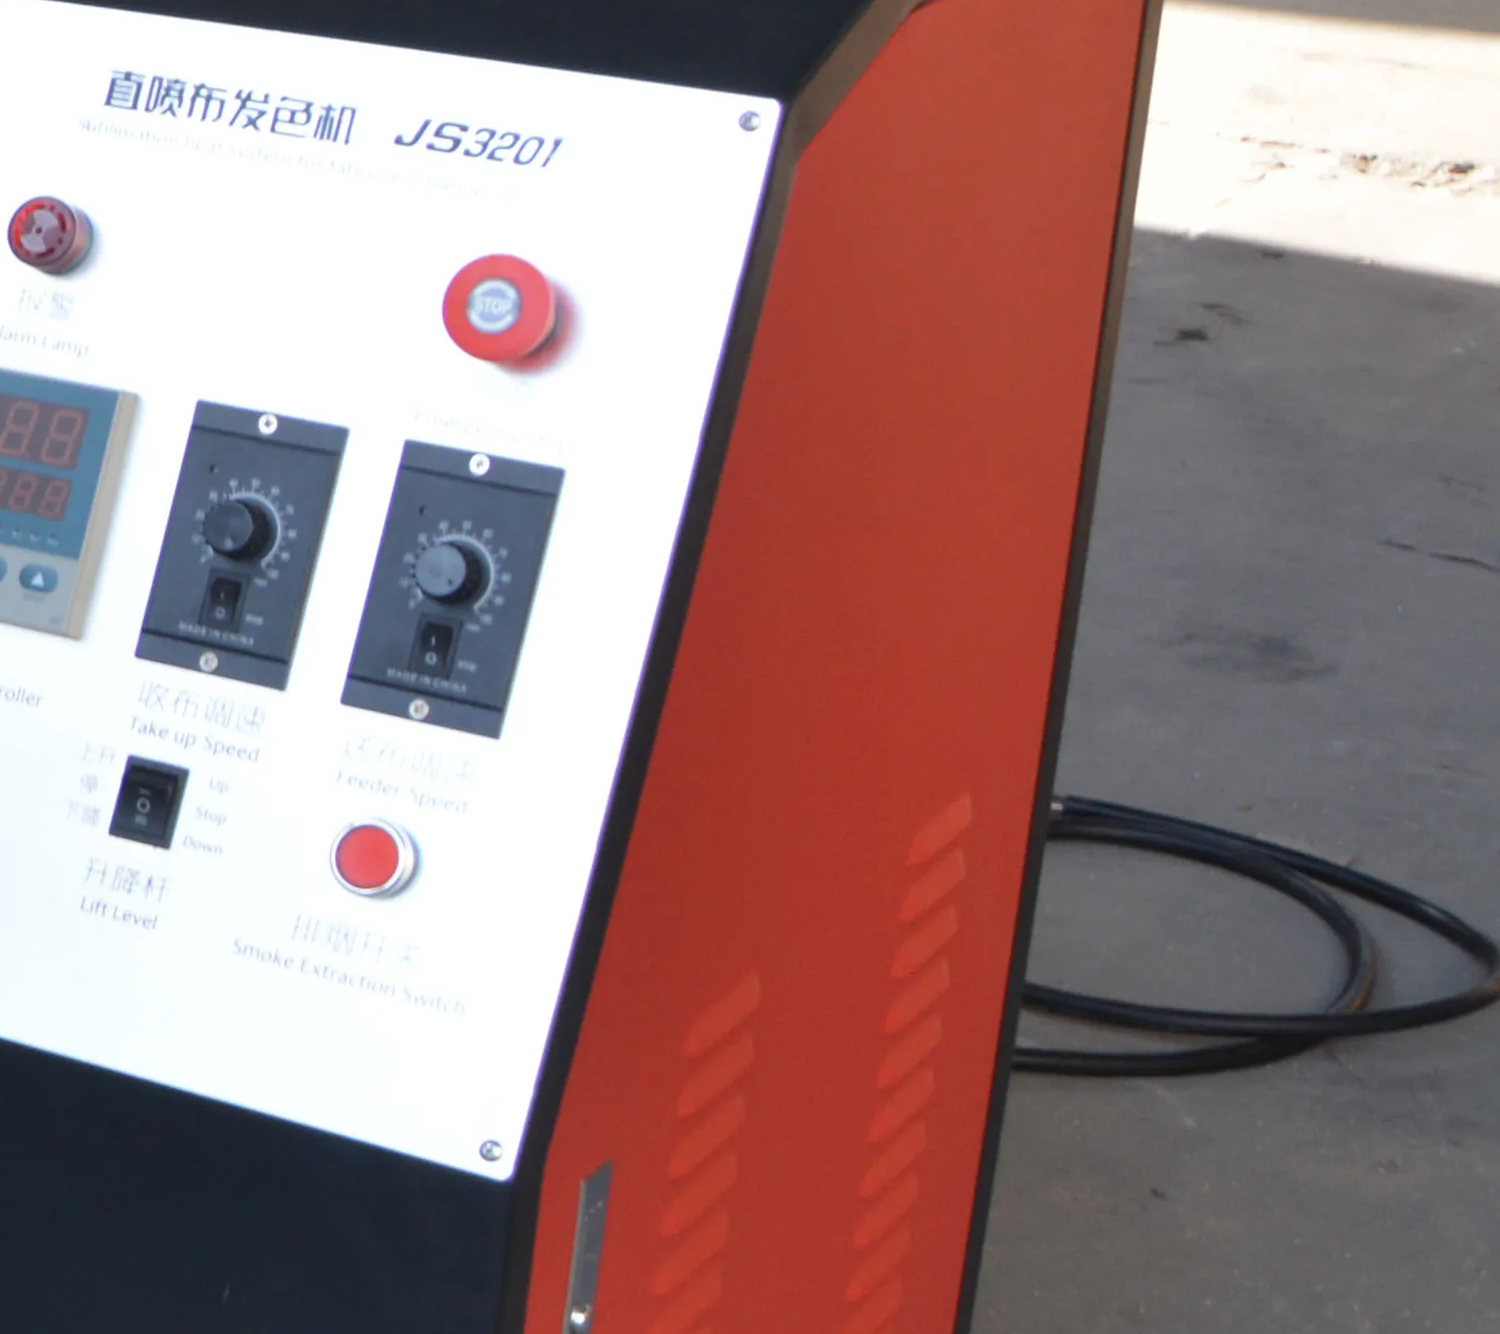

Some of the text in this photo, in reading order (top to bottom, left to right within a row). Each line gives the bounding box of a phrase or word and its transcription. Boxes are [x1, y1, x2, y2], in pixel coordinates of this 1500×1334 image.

[103, 69, 564, 167] 直喷布发色机 JS3201
[472, 296, 514, 316] STOP
[129, 713, 261, 764] Take up Speed
[209, 776, 229, 795] Up
[336, 768, 469, 816] Feeder Speed
[195, 805, 228, 828] Stop
[182, 834, 224, 857] Down
[79, 894, 159, 931] Lift Level
[230, 936, 469, 1017] Smoke Extraction Switch
